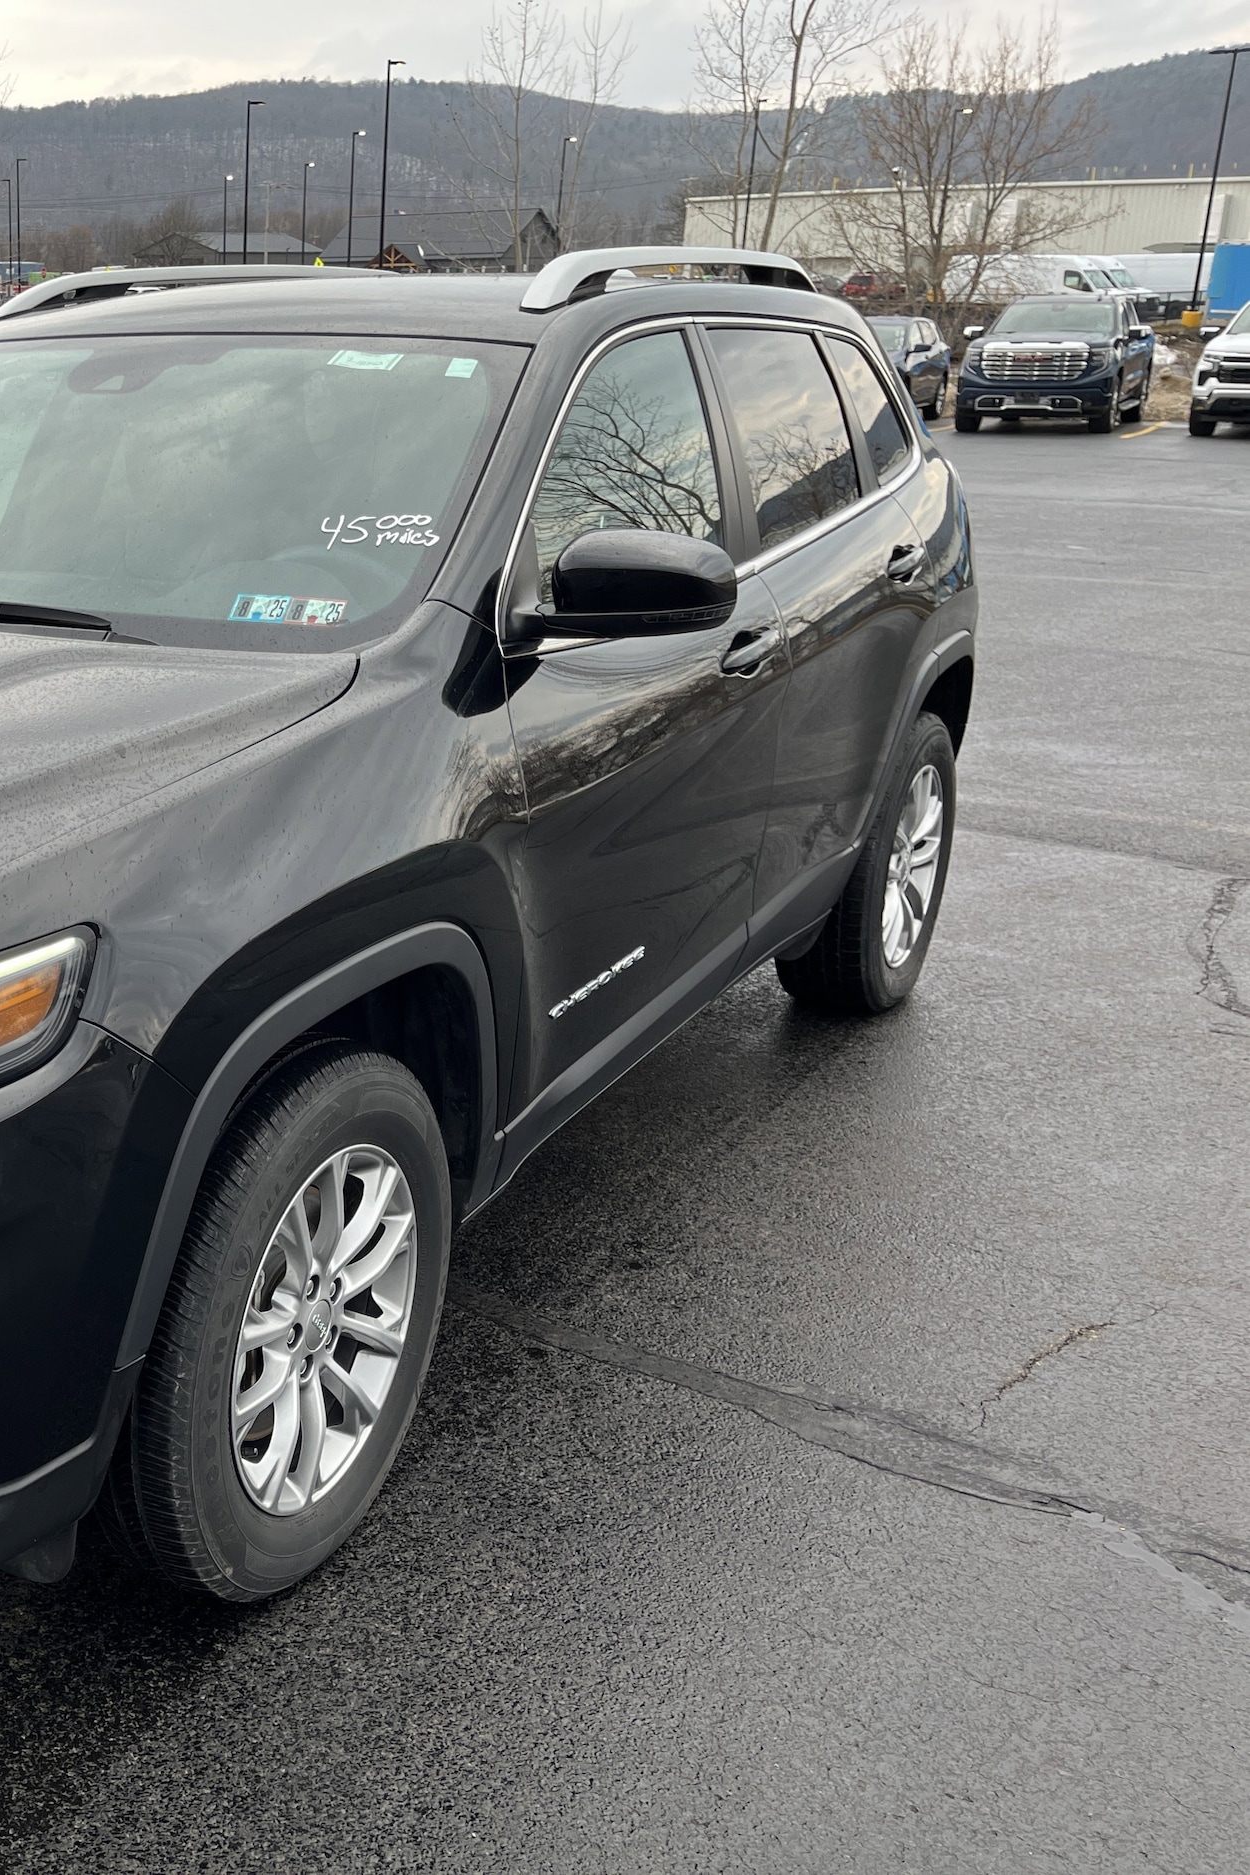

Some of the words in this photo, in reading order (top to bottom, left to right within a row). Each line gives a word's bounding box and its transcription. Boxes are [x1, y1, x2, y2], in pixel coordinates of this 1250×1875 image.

[321, 515, 376, 550] 45
[375, 514, 432, 530] 000
[238, 601, 250, 617] 8
[269, 599, 287, 618] 25
[292, 604, 304, 620] 8
[326, 603, 343, 624] 25
[312, 1313, 327, 1338] Jeep
[203, 1303, 235, 1547] Festone
